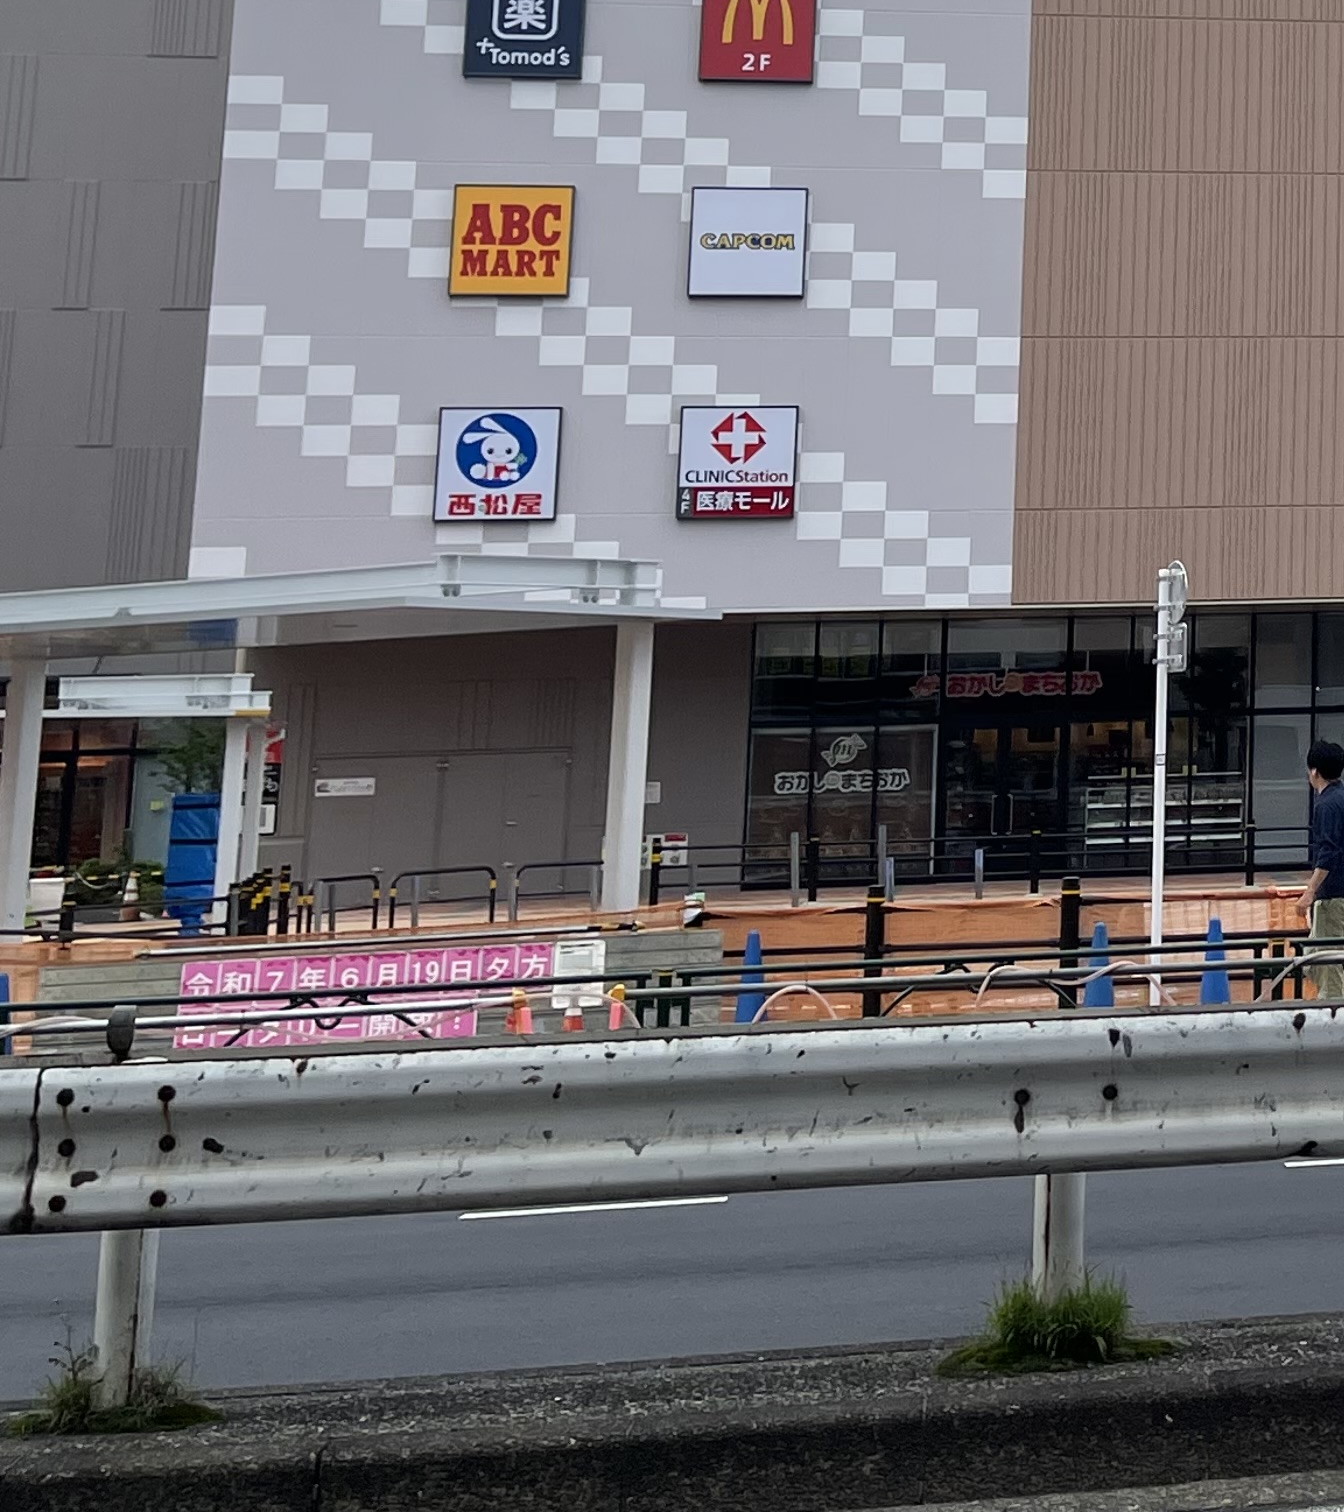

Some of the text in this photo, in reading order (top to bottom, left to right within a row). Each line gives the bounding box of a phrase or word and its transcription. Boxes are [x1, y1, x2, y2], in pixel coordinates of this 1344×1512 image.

[489, 45, 571, 67] Tomod's
[740, 52, 772, 72] 2F
[461, 203, 562, 247] ABC
[699, 232, 796, 251] CAPCOM
[460, 249, 561, 278] MART
[685, 469, 789, 484] CLINICStation
[447, 493, 543, 516] 西松屋
[695, 490, 791, 512] 医療モール
